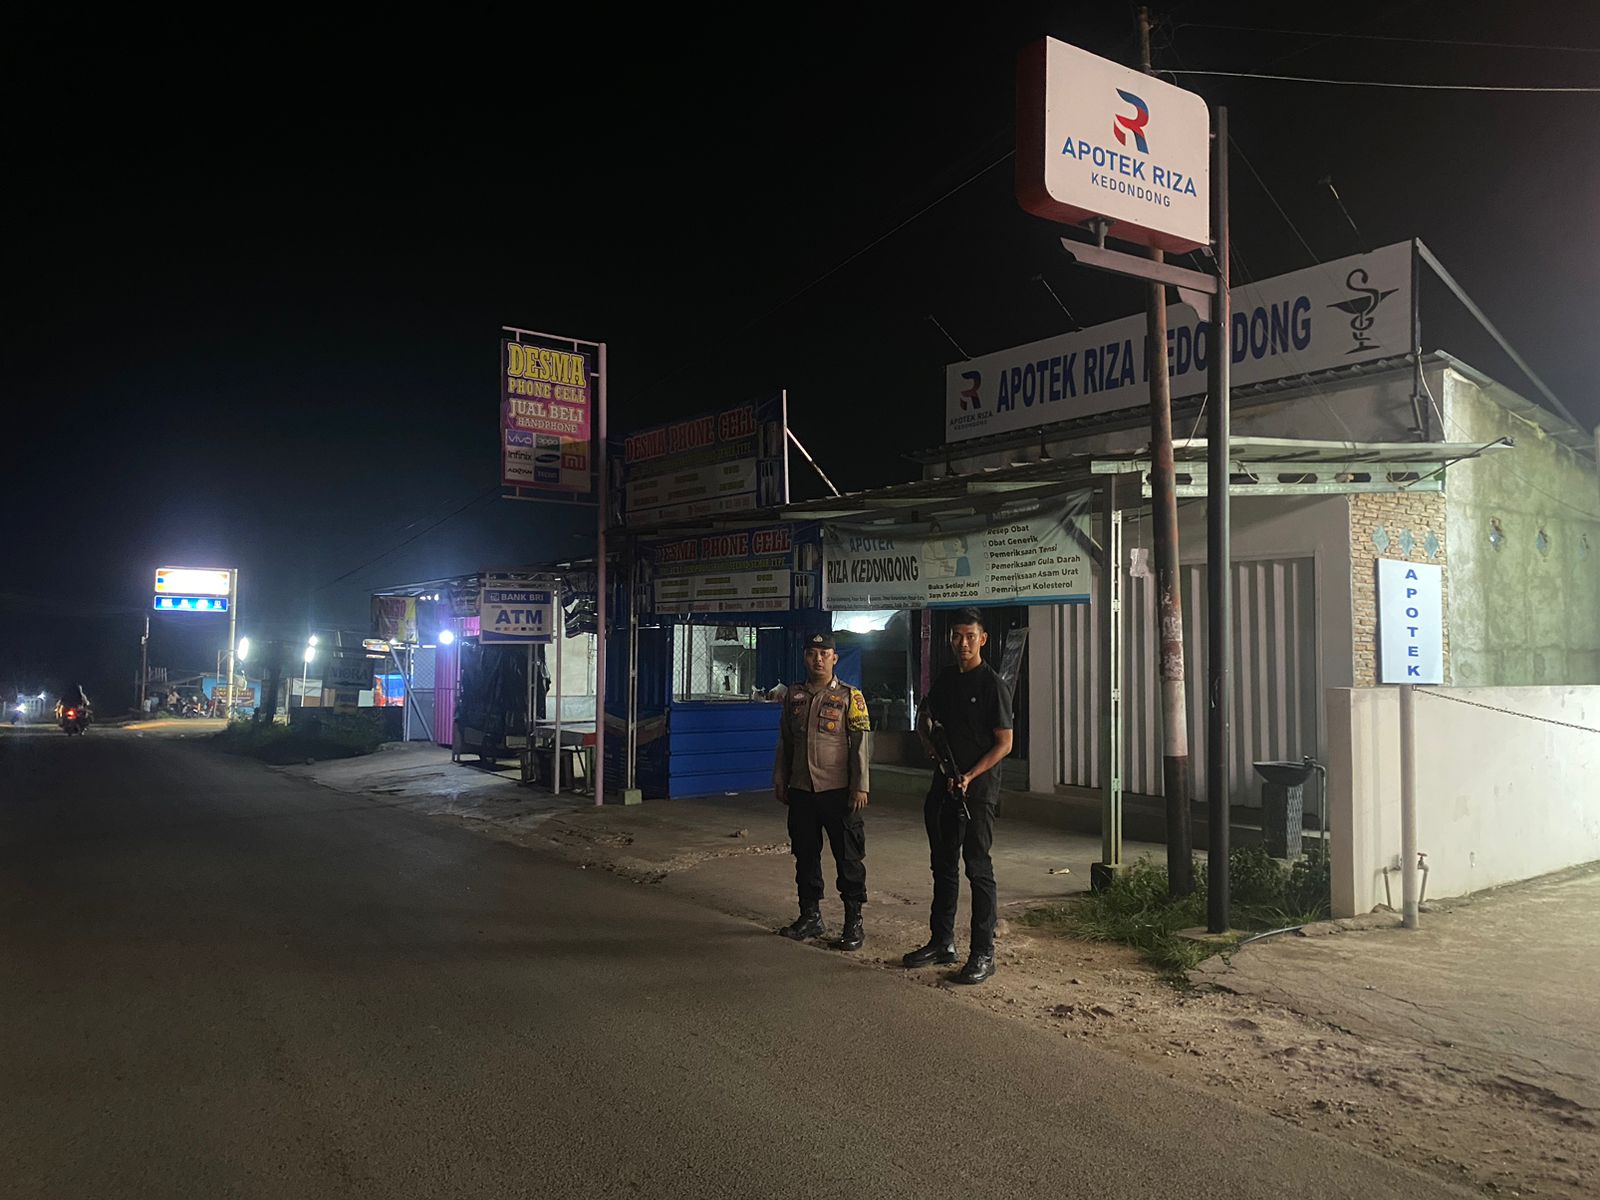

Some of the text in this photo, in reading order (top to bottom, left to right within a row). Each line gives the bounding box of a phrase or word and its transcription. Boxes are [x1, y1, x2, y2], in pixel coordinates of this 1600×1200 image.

[1062, 137, 1197, 197] APOTEK RIZA
[1091, 172, 1170, 207] KEDONDONG
[997, 295, 1311, 413] APOTEK RIZA EDODONG
[507, 342, 586, 388] DESMA
[508, 377, 586, 404] PHONE CELL
[508, 398, 585, 423] JUAL BELI
[517, 417, 578, 433] HANDPHONE
[508, 433, 532, 444] vivo
[625, 405, 757, 464] DESMA PHONE CELL
[508, 450, 532, 461] Infinix
[987, 527, 1009, 535] Resep
[700, 532, 749, 560] PHONE
[752, 528, 792, 555] CELL
[988, 535, 1039, 547] Obat Generik
[990, 544, 1058, 558] Pemeriksaan Tensi
[827, 555, 919, 583] RIZA KEDONDONG
[991, 555, 1081, 570] Pemeriksaan Gula Darah
[991, 568, 1079, 582] Pemeriksaan Asam Urat
[1032, 580, 1073, 590] Kolesterol
[501, 593, 544, 601] BANK BRI
[495, 609, 543, 624] ATM
[1405, 569, 1421, 677] APOTEK
